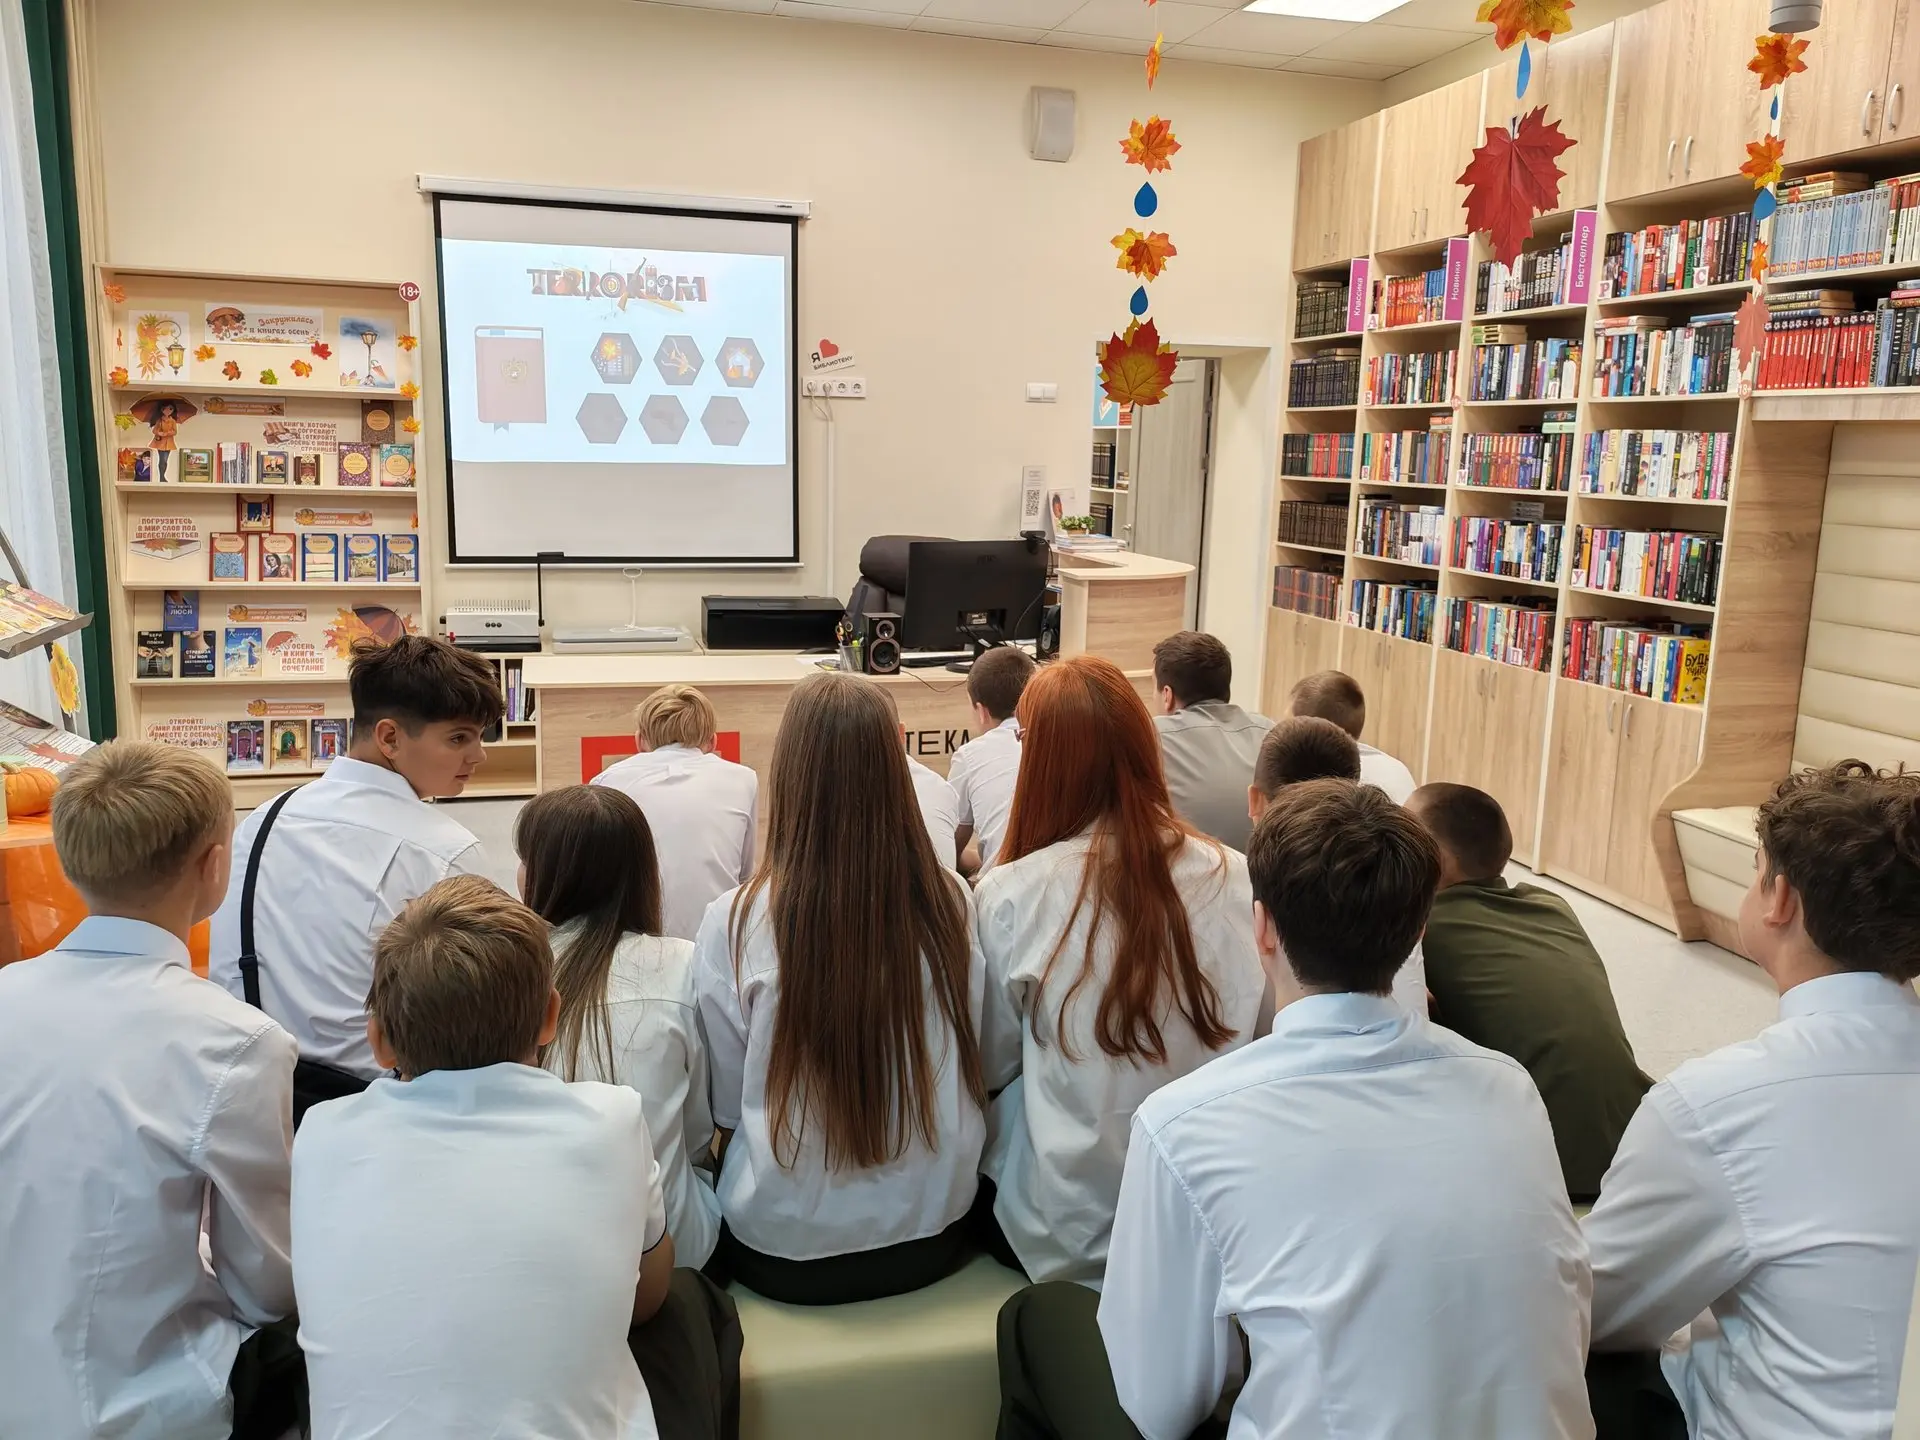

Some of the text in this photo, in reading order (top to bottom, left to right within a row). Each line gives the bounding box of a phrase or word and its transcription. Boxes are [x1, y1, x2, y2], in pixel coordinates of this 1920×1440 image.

[1575, 225, 1591, 288] Бестселлер
[1451, 261, 1461, 300] Новинки
[1694, 269, 1707, 285] С
[401, 285, 420, 297] 18+
[1354, 277, 1363, 316] Классика
[1599, 282, 1610, 297] Р
[258, 315, 314, 326] Закружилась
[1367, 315, 1378, 328] А
[811, 352, 821, 363] Я
[813, 355, 853, 370] БИБЛИОТЕКУ
[1458, 470, 1468, 483] М
[1579, 476, 1591, 491] Т
[1521, 563, 1531, 578] Н
[1572, 570, 1585, 584] У
[1510, 648, 1522, 665] П
[169, 717, 204, 725] ОТКРОЙТЕ
